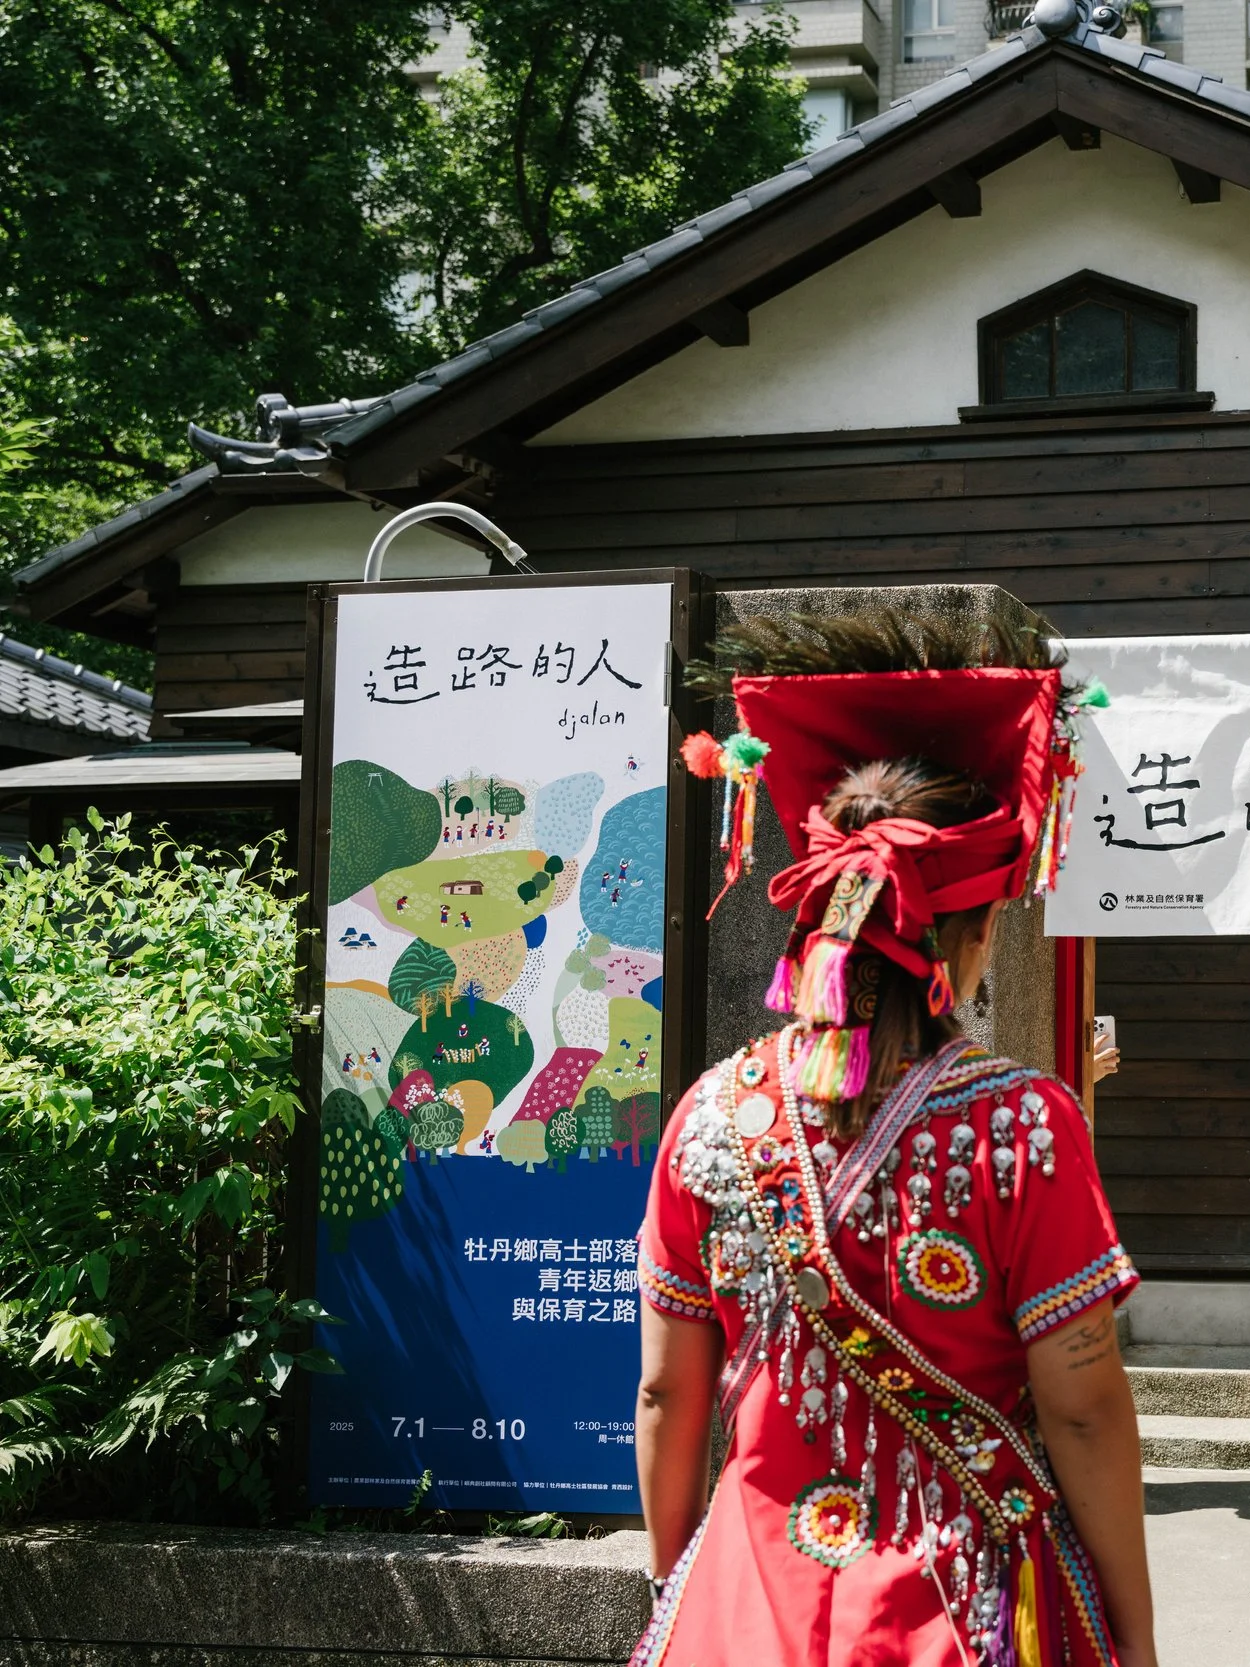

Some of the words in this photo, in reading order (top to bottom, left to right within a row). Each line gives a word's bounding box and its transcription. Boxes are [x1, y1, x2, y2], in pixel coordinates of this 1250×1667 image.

[363, 638, 643, 705] 造路的人
[558, 700, 626, 740] djalan
[1124, 893, 1205, 904] 林業及自然保育署
[463, 1237, 639, 1264] 牡丹鄉高士部落
[537, 1267, 638, 1293] 青年返鄉
[511, 1297, 637, 1324] 與保育之路
[329, 1421, 355, 1431] 2025
